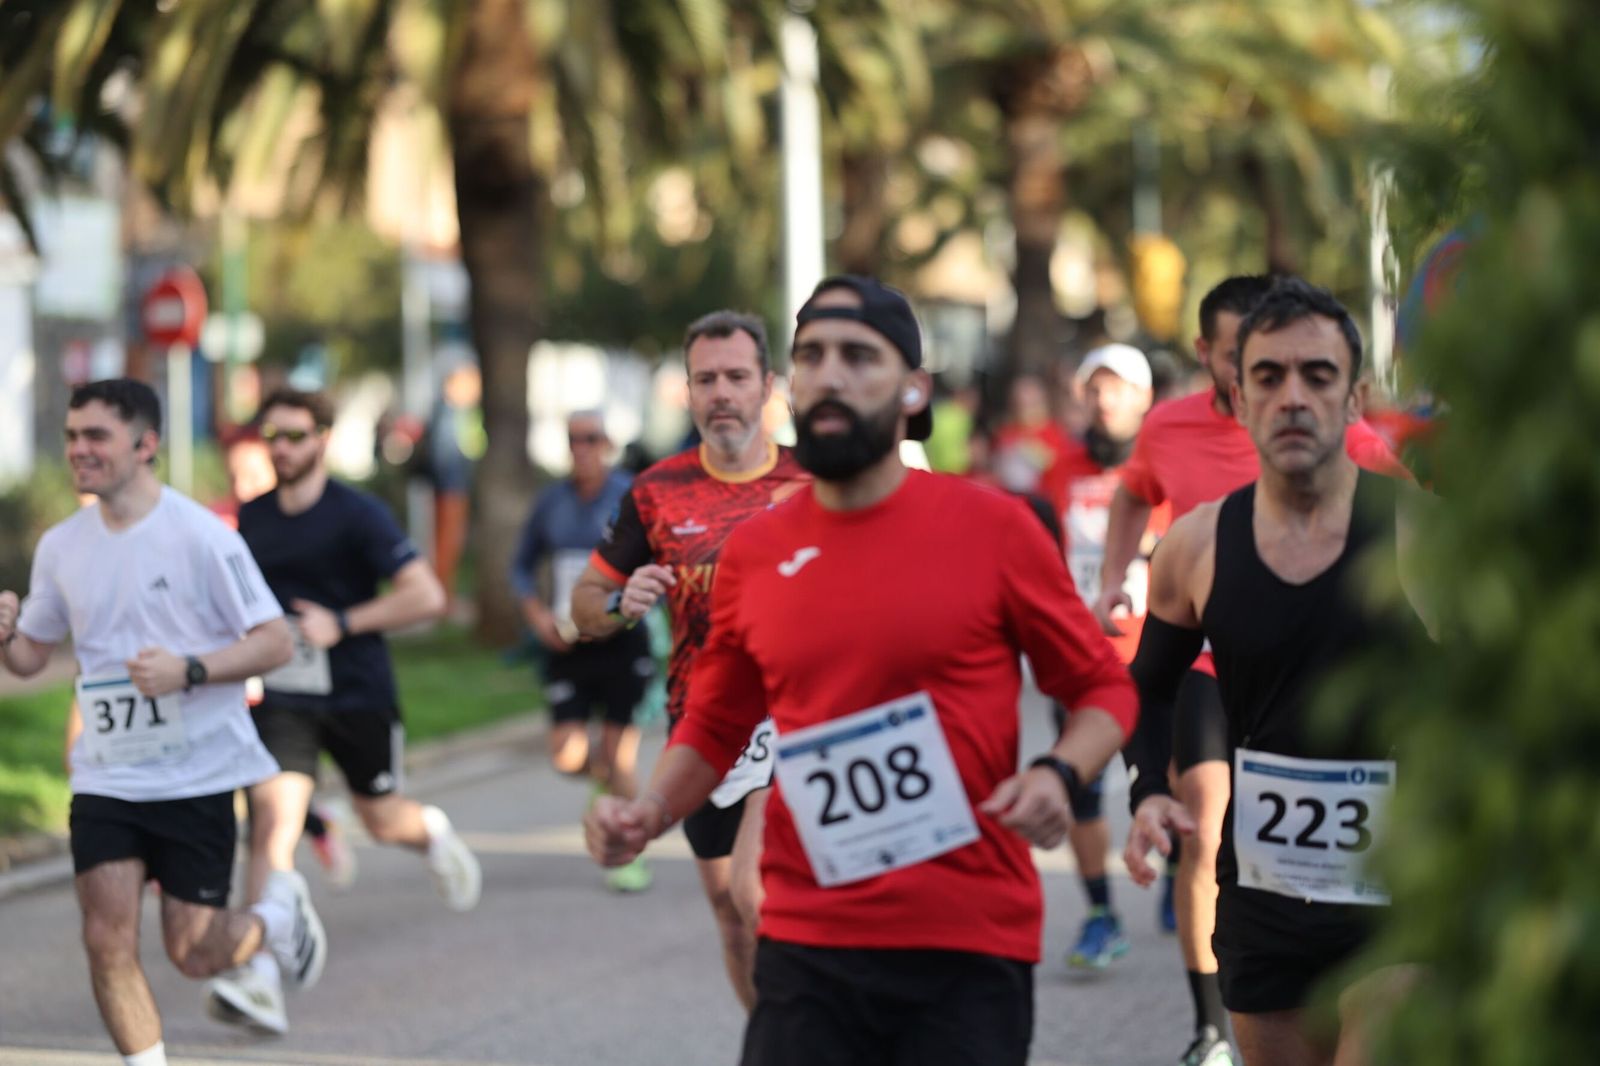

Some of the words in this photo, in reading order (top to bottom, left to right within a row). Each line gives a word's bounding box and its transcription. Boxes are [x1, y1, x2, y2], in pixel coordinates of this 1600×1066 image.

[93, 696, 167, 733] 371
[742, 731, 771, 763] S
[806, 743, 931, 826] 208
[1257, 791, 1373, 853] 223
